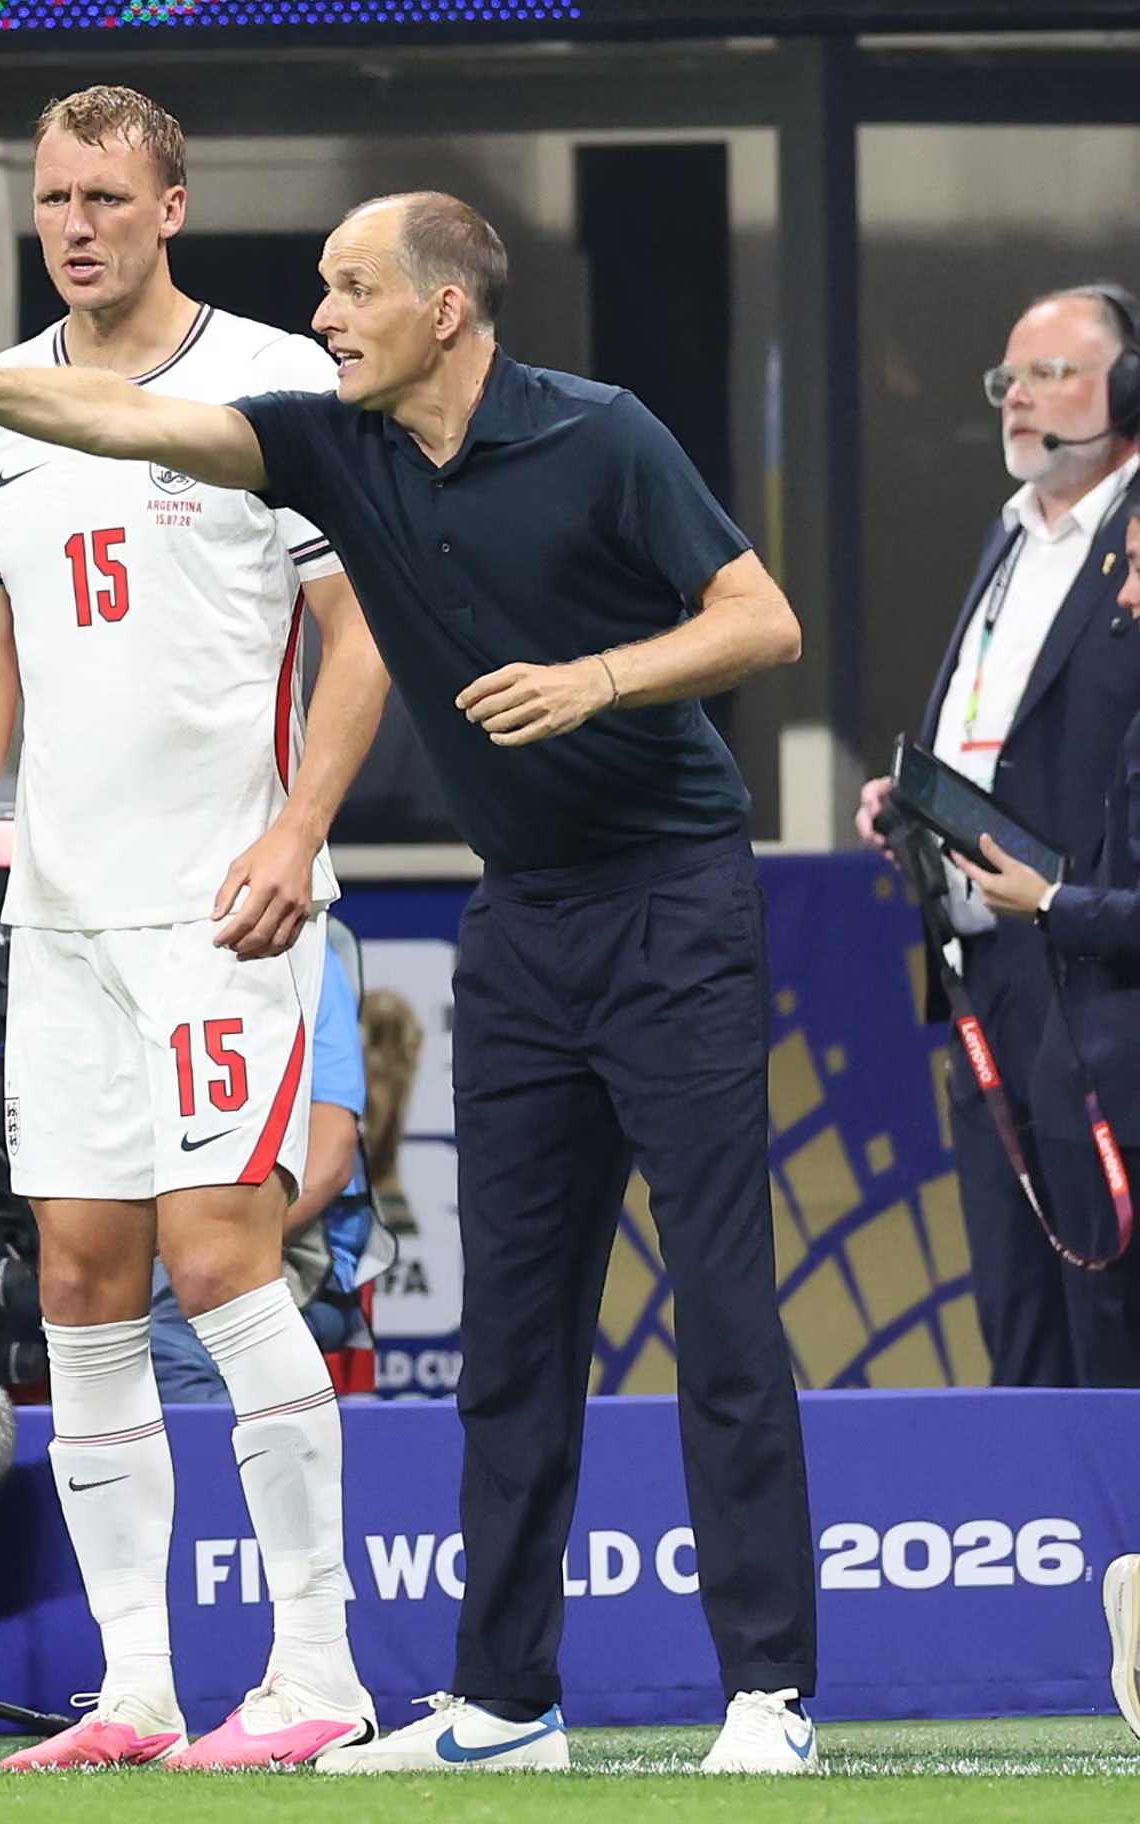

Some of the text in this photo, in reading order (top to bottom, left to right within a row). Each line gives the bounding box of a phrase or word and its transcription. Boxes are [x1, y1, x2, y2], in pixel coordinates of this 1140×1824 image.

[147, 500, 202, 513] ARGENTINA
[156, 514, 191, 526] 15.07.26
[64, 527, 129, 627] 15
[170, 1017, 249, 1117] 15
[961, 1021, 994, 1083] Lenovo
[819, 1518, 1085, 1589] 2026
